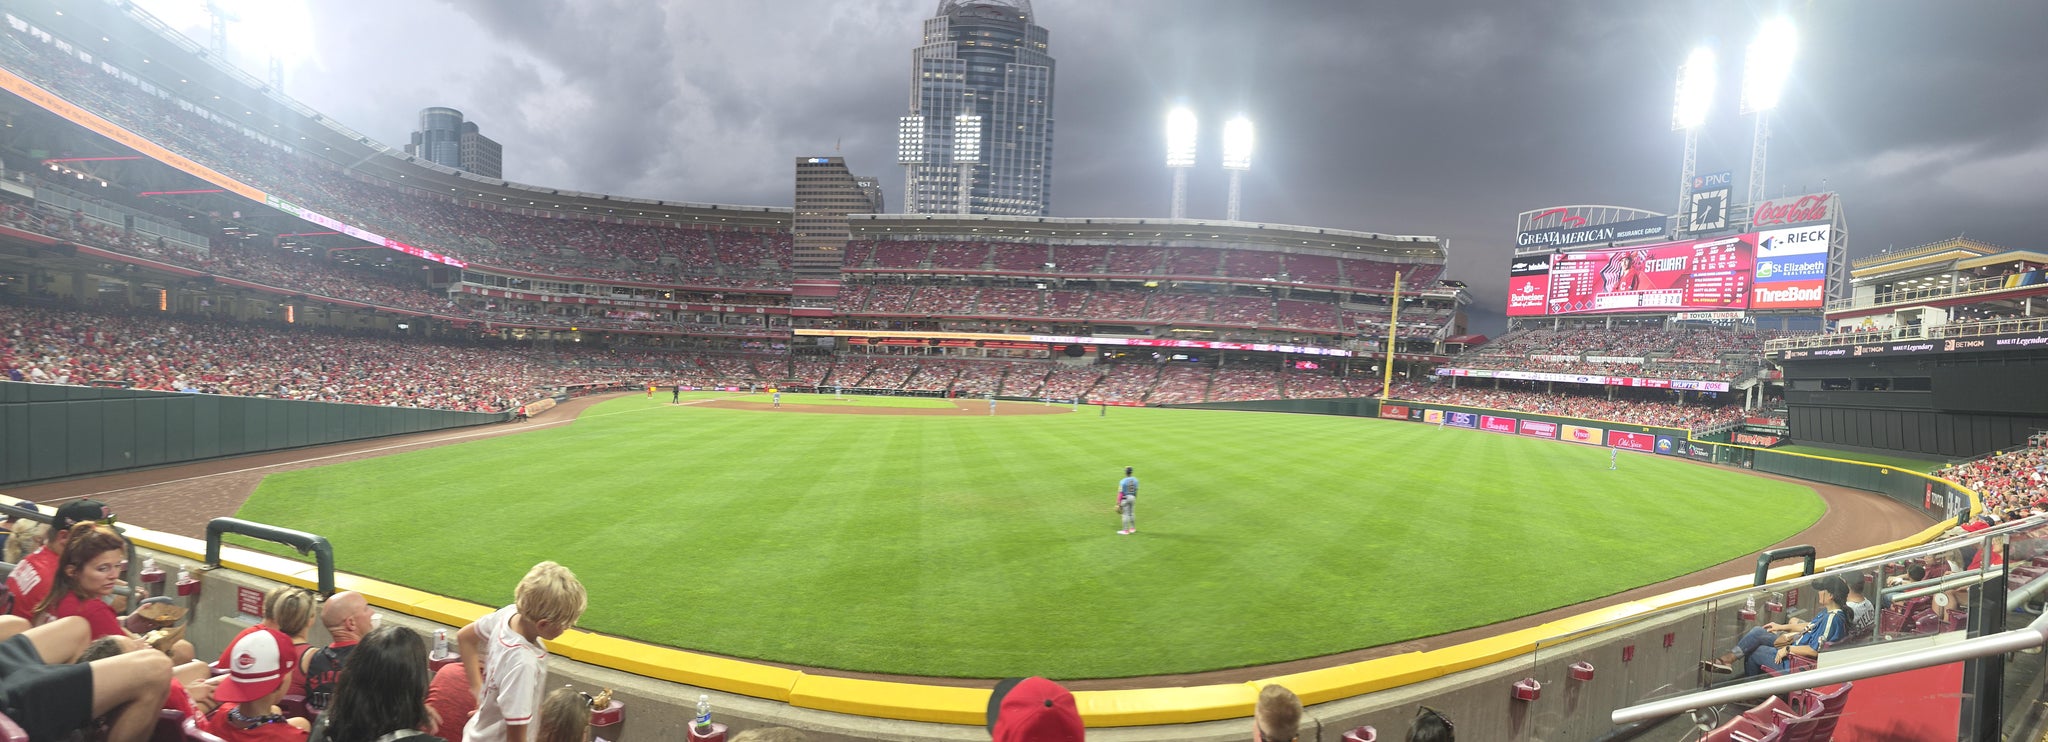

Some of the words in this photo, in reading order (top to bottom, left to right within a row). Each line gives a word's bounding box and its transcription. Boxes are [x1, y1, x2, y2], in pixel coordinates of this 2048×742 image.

[1705, 173, 1730, 186] PNC
[1518, 232, 1555, 245] GREAT
[1551, 227, 1615, 246] AMERICAN
[1616, 230, 1643, 238] INSURANCE
[1644, 226, 1662, 235] GROUP
[1787, 230, 1826, 243] RIECK
[1644, 256, 1688, 273] STEWART
[1783, 261, 1825, 271] Elizabeth
[1754, 285, 1822, 303] ThreeBond
[1907, 343, 1934, 352] Legendary
[1956, 340, 1984, 348] BETMGM
[1574, 430, 1589, 438] Tyson
[1617, 438, 1630, 447] Old
[1630, 439, 1643, 449] Spice
